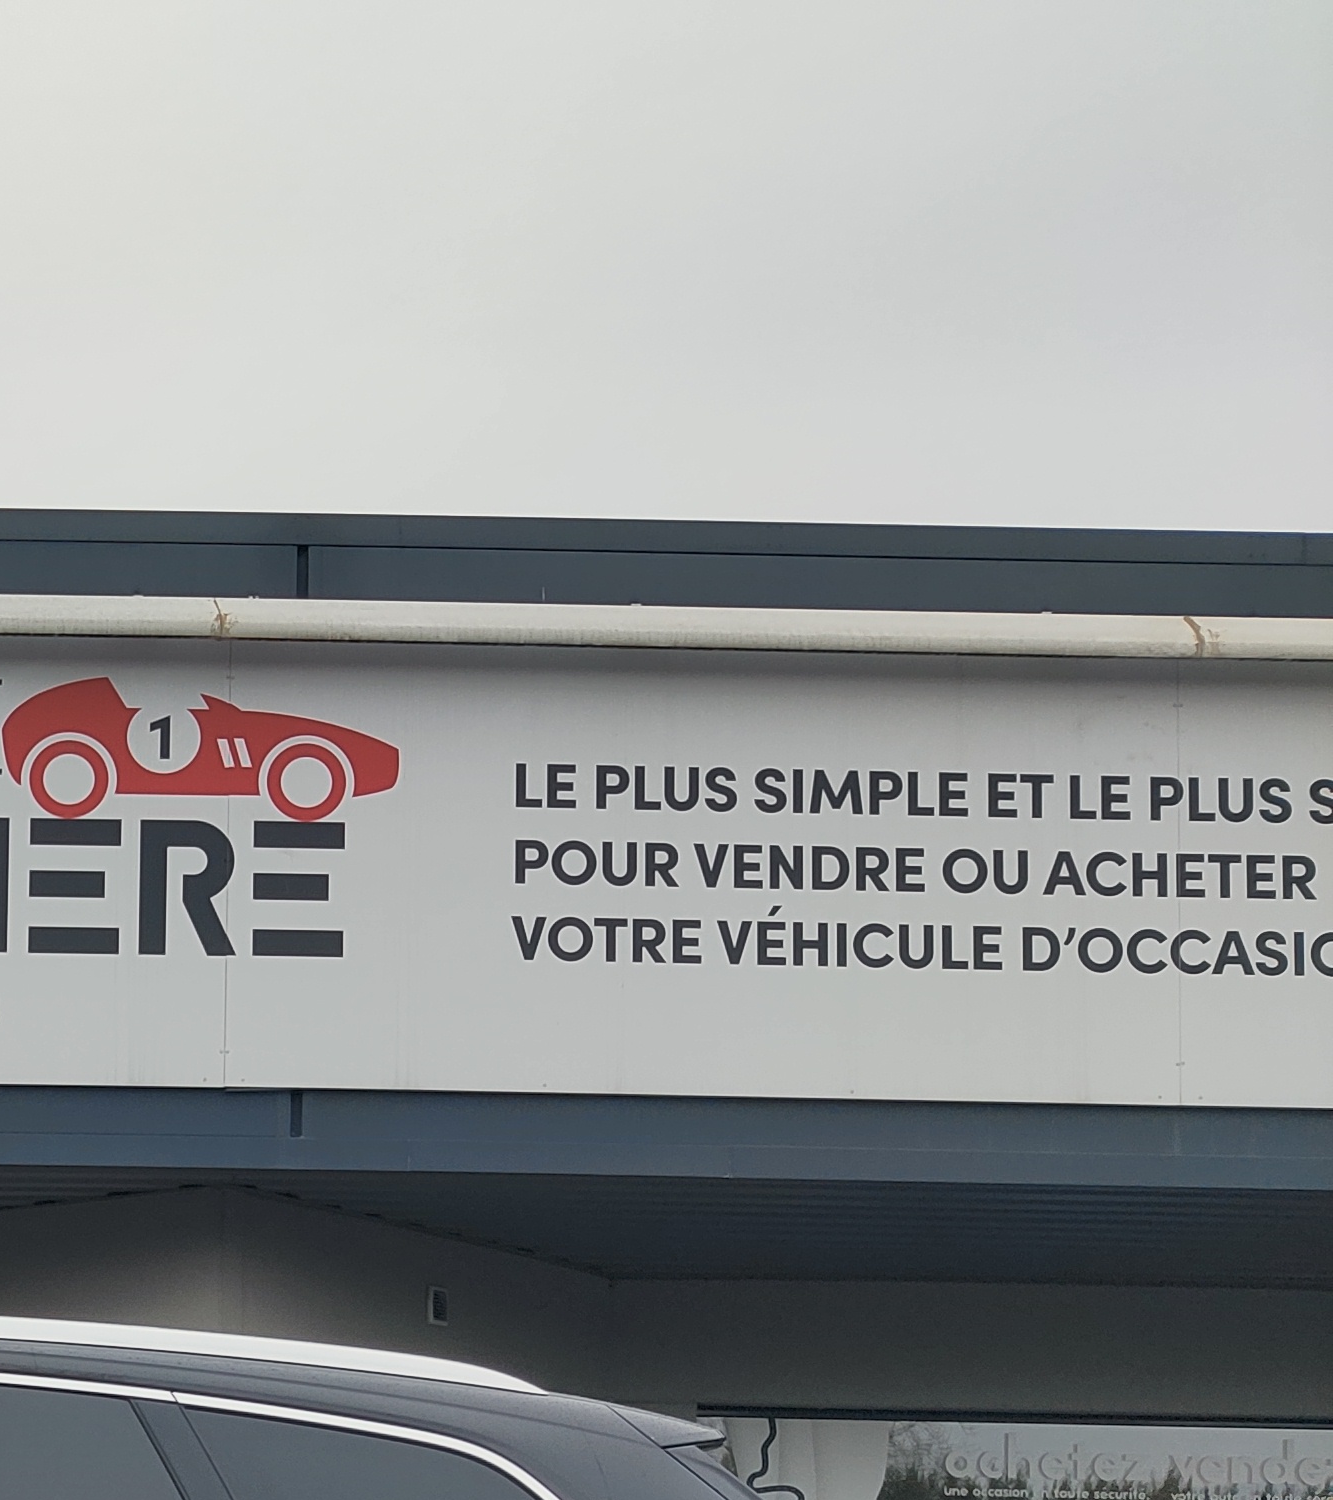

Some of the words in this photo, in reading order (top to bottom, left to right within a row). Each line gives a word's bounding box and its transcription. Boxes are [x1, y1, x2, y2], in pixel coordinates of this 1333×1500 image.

[149, 716, 172, 759] 1
[515, 763, 577, 808] LE
[595, 764, 738, 813] PLUS
[754, 768, 969, 817] SIMPLE
[987, 772, 1054, 819] ET
[1069, 774, 1131, 820] LE
[1149, 776, 1293, 824] PLUS
[1309, 778, 1333, 825] S
[514, 839, 680, 888] POUR
[693, 843, 926, 893] VENDRE
[942, 848, 1029, 895] OU
[1042, 850, 1317, 900] ACHETER
[511, 915, 702, 964] VOTRE
[716, 905, 1003, 971] VÉHICULE
[1167, 1438, 1333, 1487] vende
[943, 1486, 969, 1498] une
[972, 1486, 1028, 1499] occasion
[1053, 1487, 1090, 1500] toute
